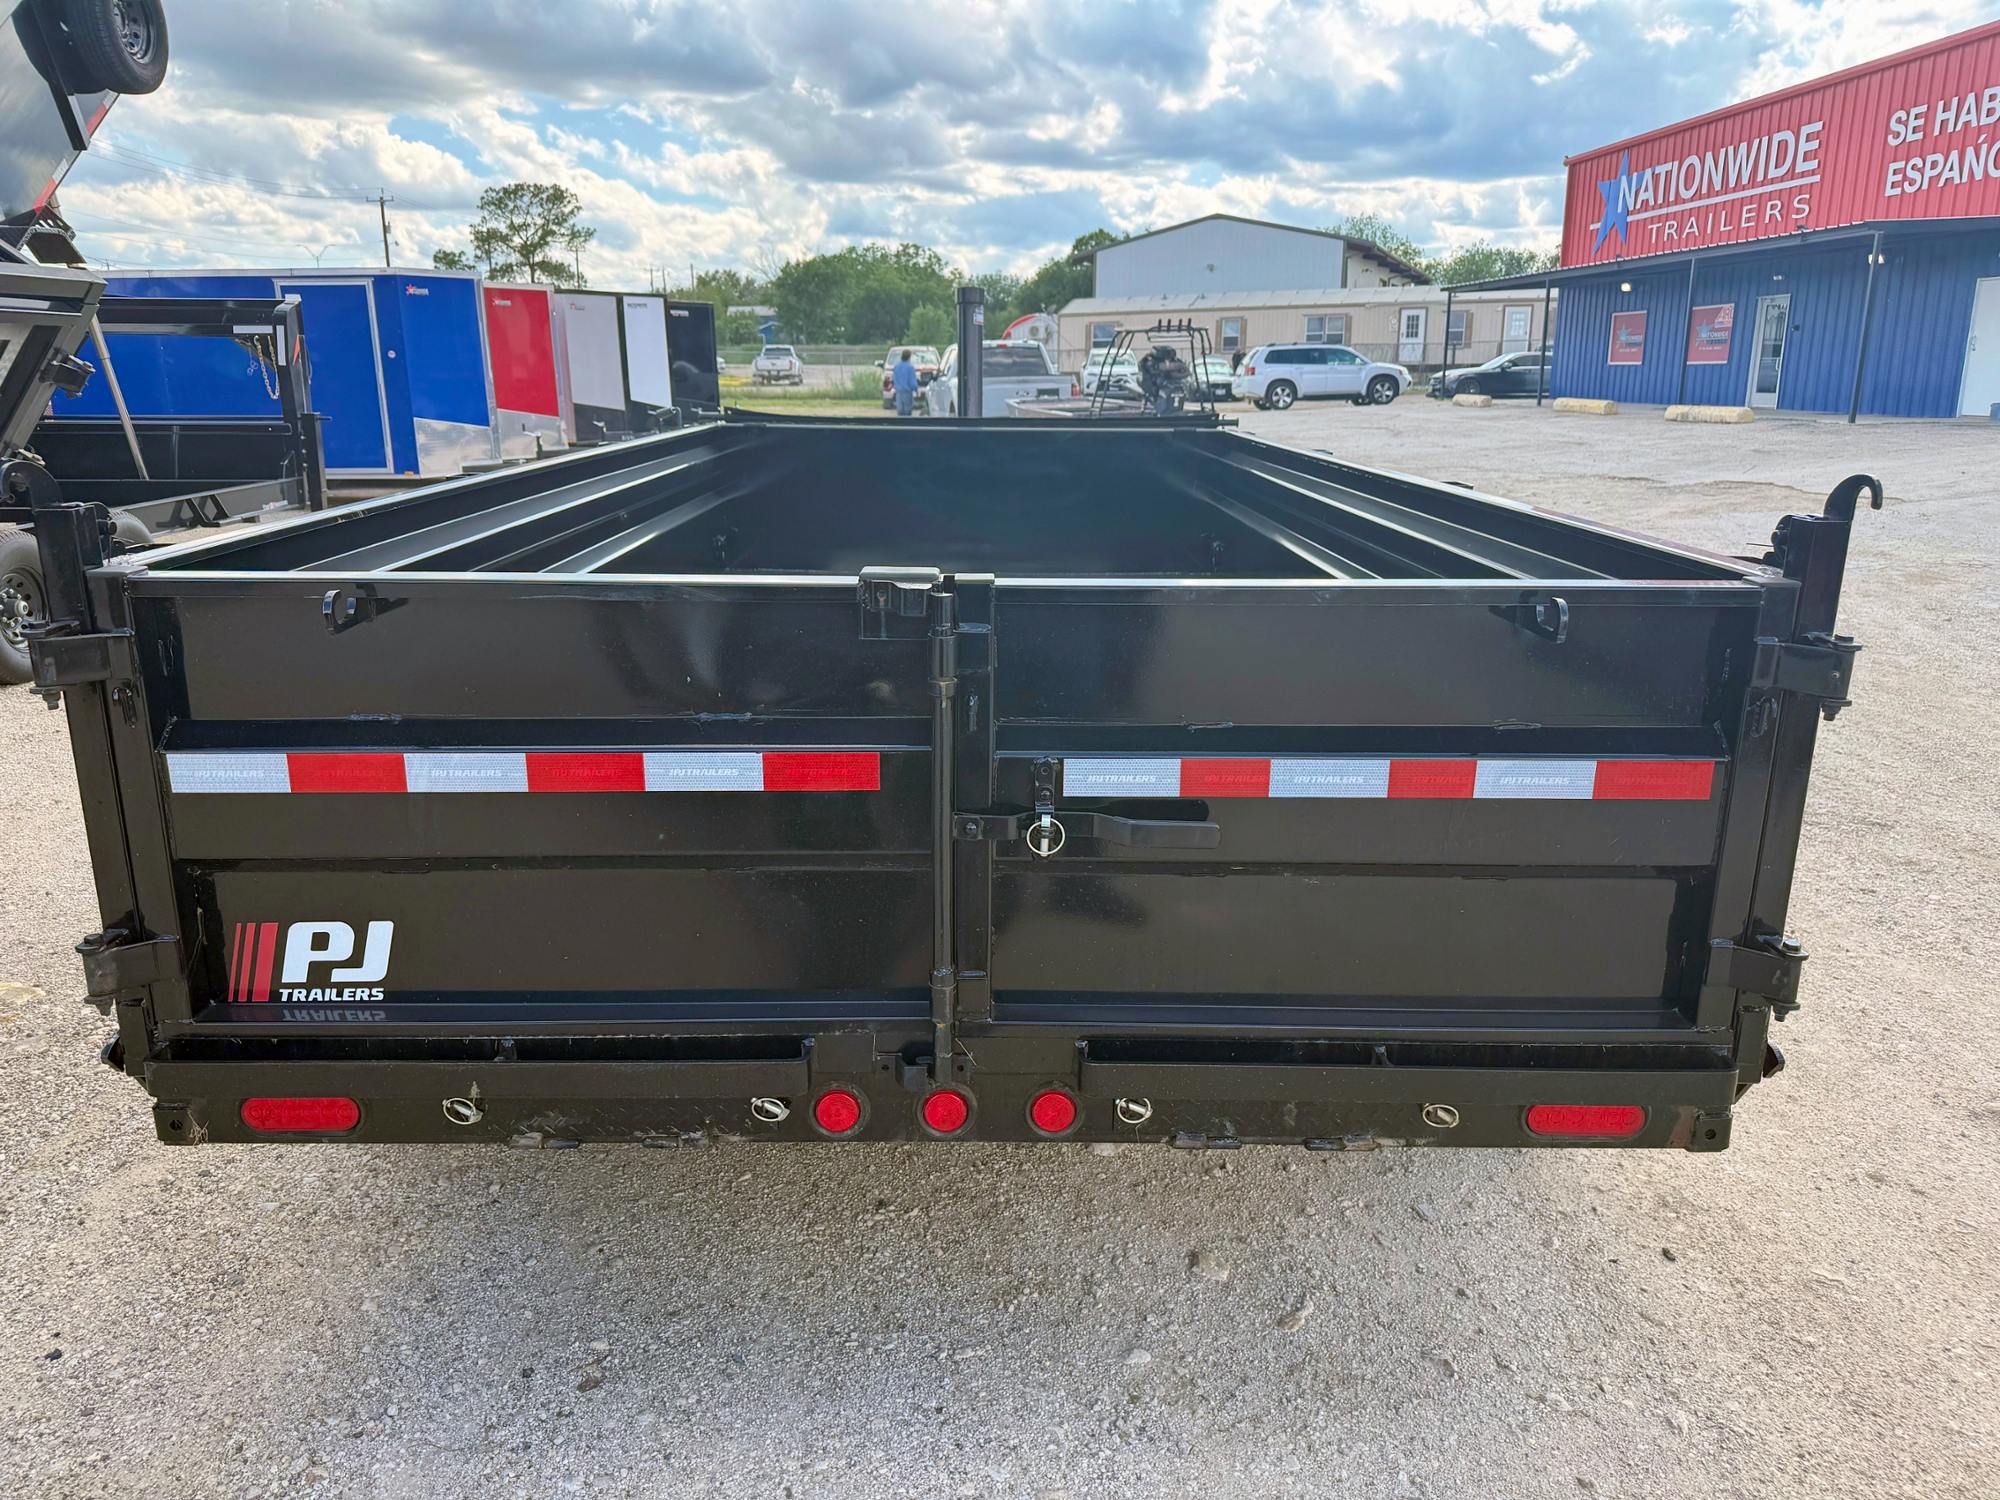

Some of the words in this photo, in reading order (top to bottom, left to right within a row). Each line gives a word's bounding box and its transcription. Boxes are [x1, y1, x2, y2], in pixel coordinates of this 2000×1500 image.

[1887, 104, 1928, 146] SE
[1617, 120, 1824, 214] NATIONWIDE
[1648, 194, 1810, 244] TRAILERS
[281, 920, 394, 983] PJ
[279, 987, 385, 1002] TRAILERS
